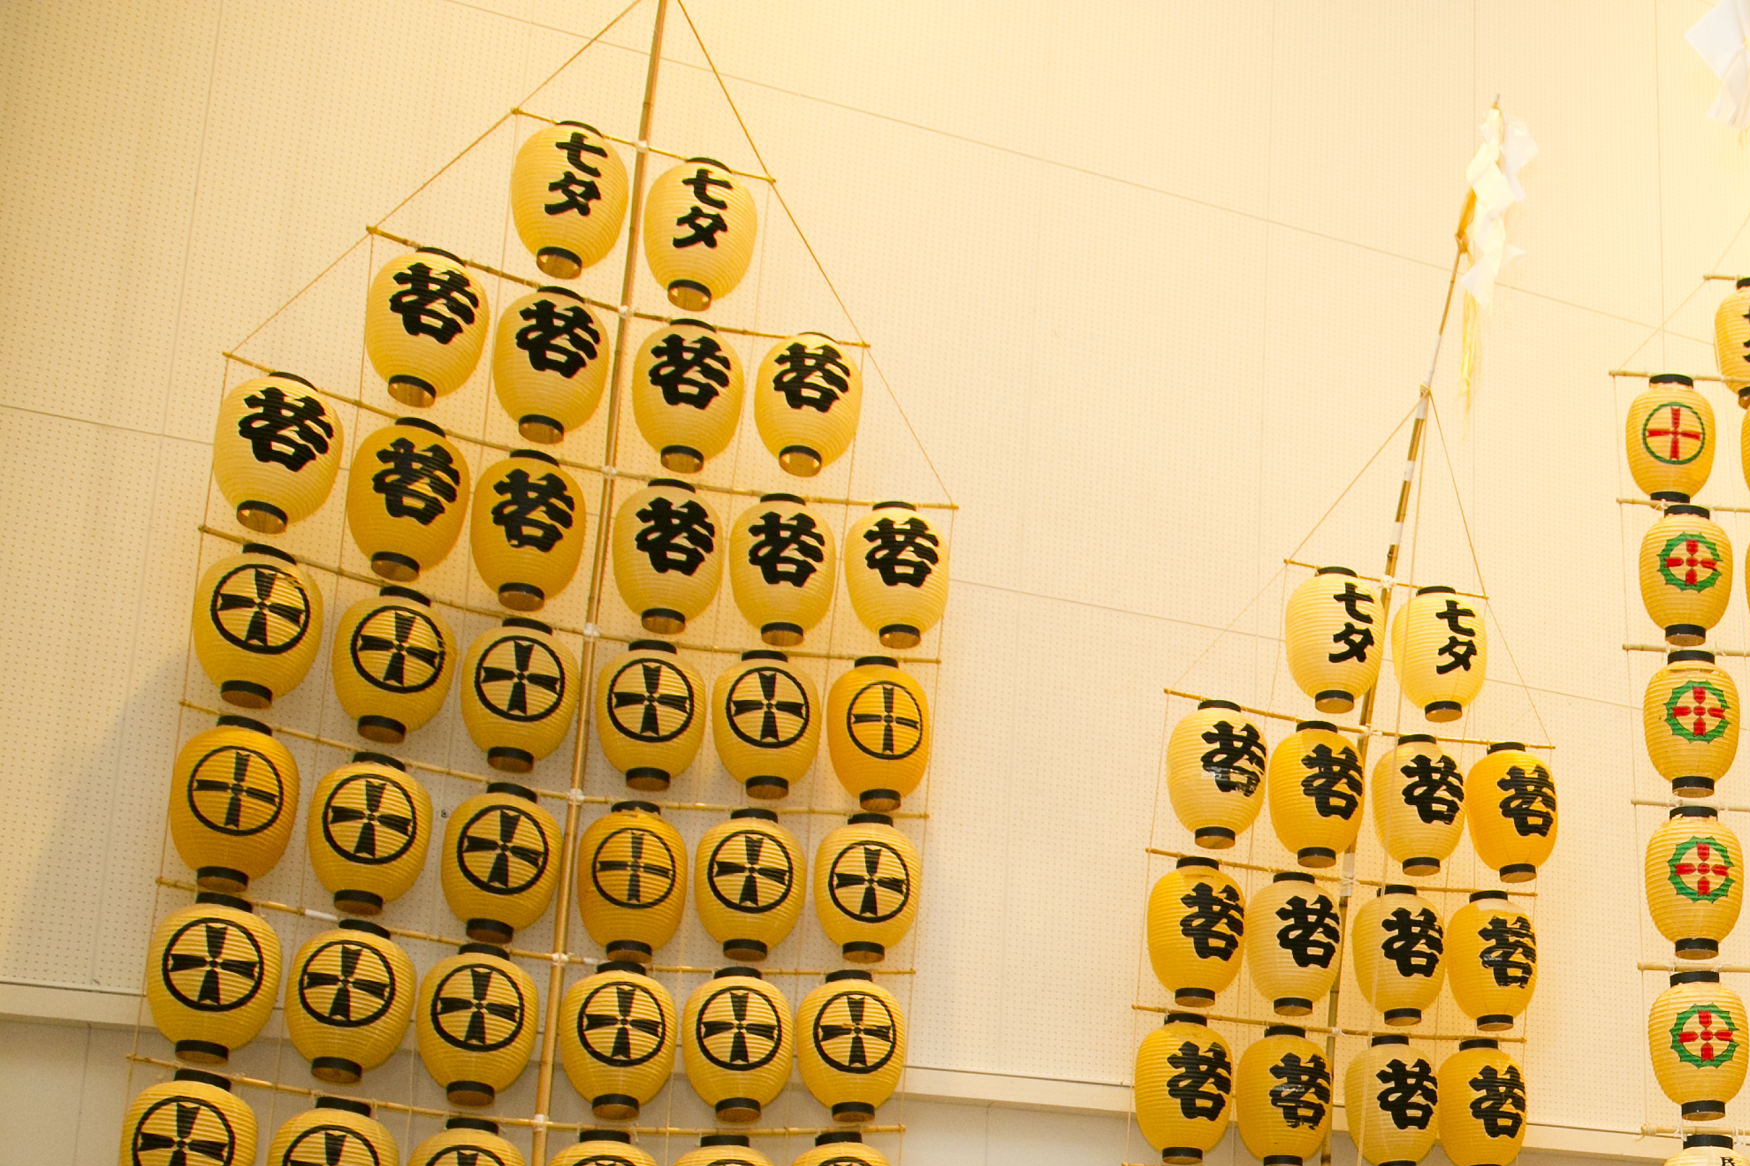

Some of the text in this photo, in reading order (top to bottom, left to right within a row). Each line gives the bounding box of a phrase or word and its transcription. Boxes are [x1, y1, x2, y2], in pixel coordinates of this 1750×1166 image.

[545, 133, 606, 215] 七夕
[673, 169, 731, 248] 七夕
[389, 263, 478, 344] 若
[516, 300, 599, 378] 若
[649, 334, 729, 409] 若
[773, 343, 849, 412] 若
[239, 387, 332, 471] 若
[372, 438, 459, 525] 若
[491, 469, 574, 552] 若
[635, 497, 714, 576] 若
[749, 512, 824, 587] 若
[863, 516, 938, 588] 若
[1329, 583, 1373, 663] 七夕
[1436, 600, 1476, 674] 七夕
[1201, 721, 1265, 796] 若
[1301, 744, 1362, 820] 若
[1401, 755, 1463, 824] 若
[1497, 767, 1555, 836] 若
[1180, 883, 1244, 961] 若
[1276, 895, 1339, 968] 若
[1382, 908, 1443, 977] 若
[1478, 917, 1535, 988] 若
[1167, 1042, 1231, 1121] 若
[1269, 1053, 1330, 1130] 若
[1376, 1059, 1437, 1129] 若
[1469, 1066, 1525, 1138] 若
